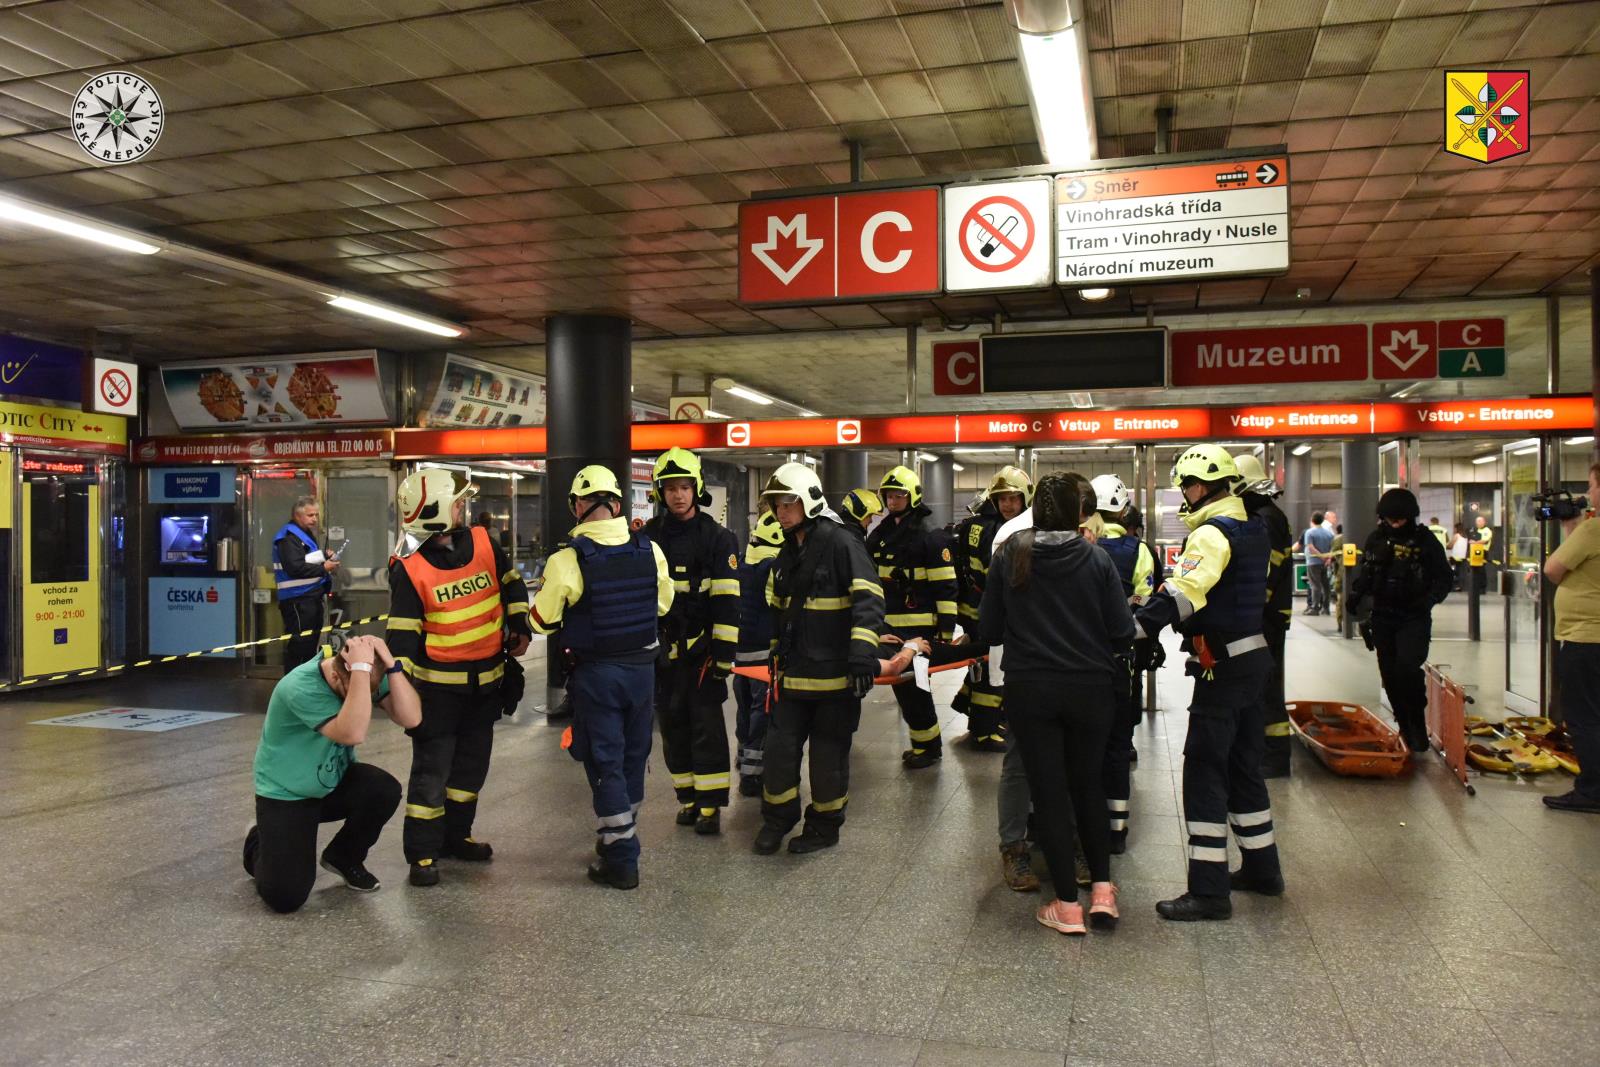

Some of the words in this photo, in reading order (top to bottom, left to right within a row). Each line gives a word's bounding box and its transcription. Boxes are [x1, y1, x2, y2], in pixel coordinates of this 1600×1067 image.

[1094, 178, 1140, 194] Směr
[1066, 202, 1175, 224] Vinohradská
[1181, 199, 1222, 215] třída
[860, 210, 913, 274] C
[1067, 236, 1109, 250] Tram
[1122, 227, 1212, 247] Vinohrady
[1226, 222, 1278, 239] Nusle
[1065, 259, 1134, 278] Národní
[1139, 257, 1214, 273] muzeum
[1461, 324, 1482, 346] C
[1197, 343, 1341, 369] Muzeum
[1461, 351, 1482, 373] A
[947, 351, 976, 386] C
[40, 412, 77, 432] CITY
[1231, 415, 1275, 429] Vstup
[1288, 413, 1359, 426] Entrance
[1418, 410, 1465, 424] Vstup
[1479, 407, 1554, 421] Entrance
[988, 421, 1027, 433] Metro
[1032, 421, 1042, 432] C
[1059, 420, 1101, 435] Vstup
[1113, 418, 1179, 430] Entrance
[316, 442, 325, 453] NA
[327, 441, 339, 453] TEL.
[341, 440, 352, 452] 722
[353, 440, 363, 452] 00
[364, 440, 374, 451] 00
[42, 586, 67, 595] vchod
[69, 586, 78, 594] za
[167, 586, 204, 603] ČESKÁ
[436, 573, 492, 603] HASIČI
[48, 597, 73, 606] rohem
[35, 612, 54, 621] 9:00
[63, 610, 85, 619] 21:00
